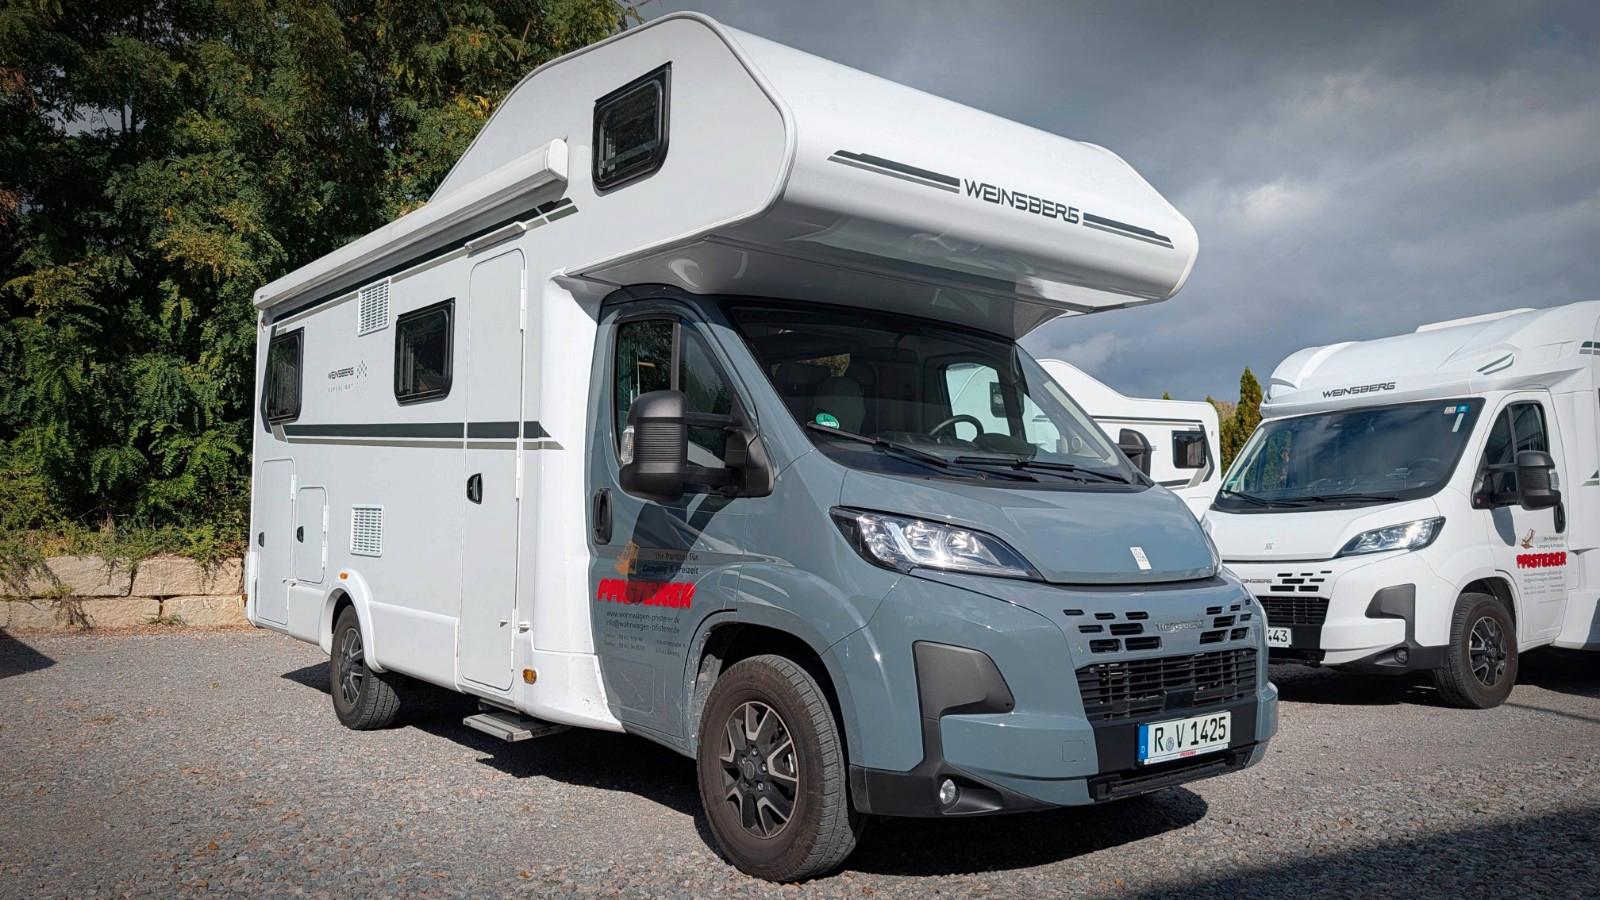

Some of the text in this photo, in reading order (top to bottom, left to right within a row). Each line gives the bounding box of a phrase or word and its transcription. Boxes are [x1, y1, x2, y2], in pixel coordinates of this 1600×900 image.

[964, 178, 1080, 224] WEINSBERG
[1322, 381, 1397, 399] WEINSBERG
[1154, 716, 1227, 753] R V 1425
